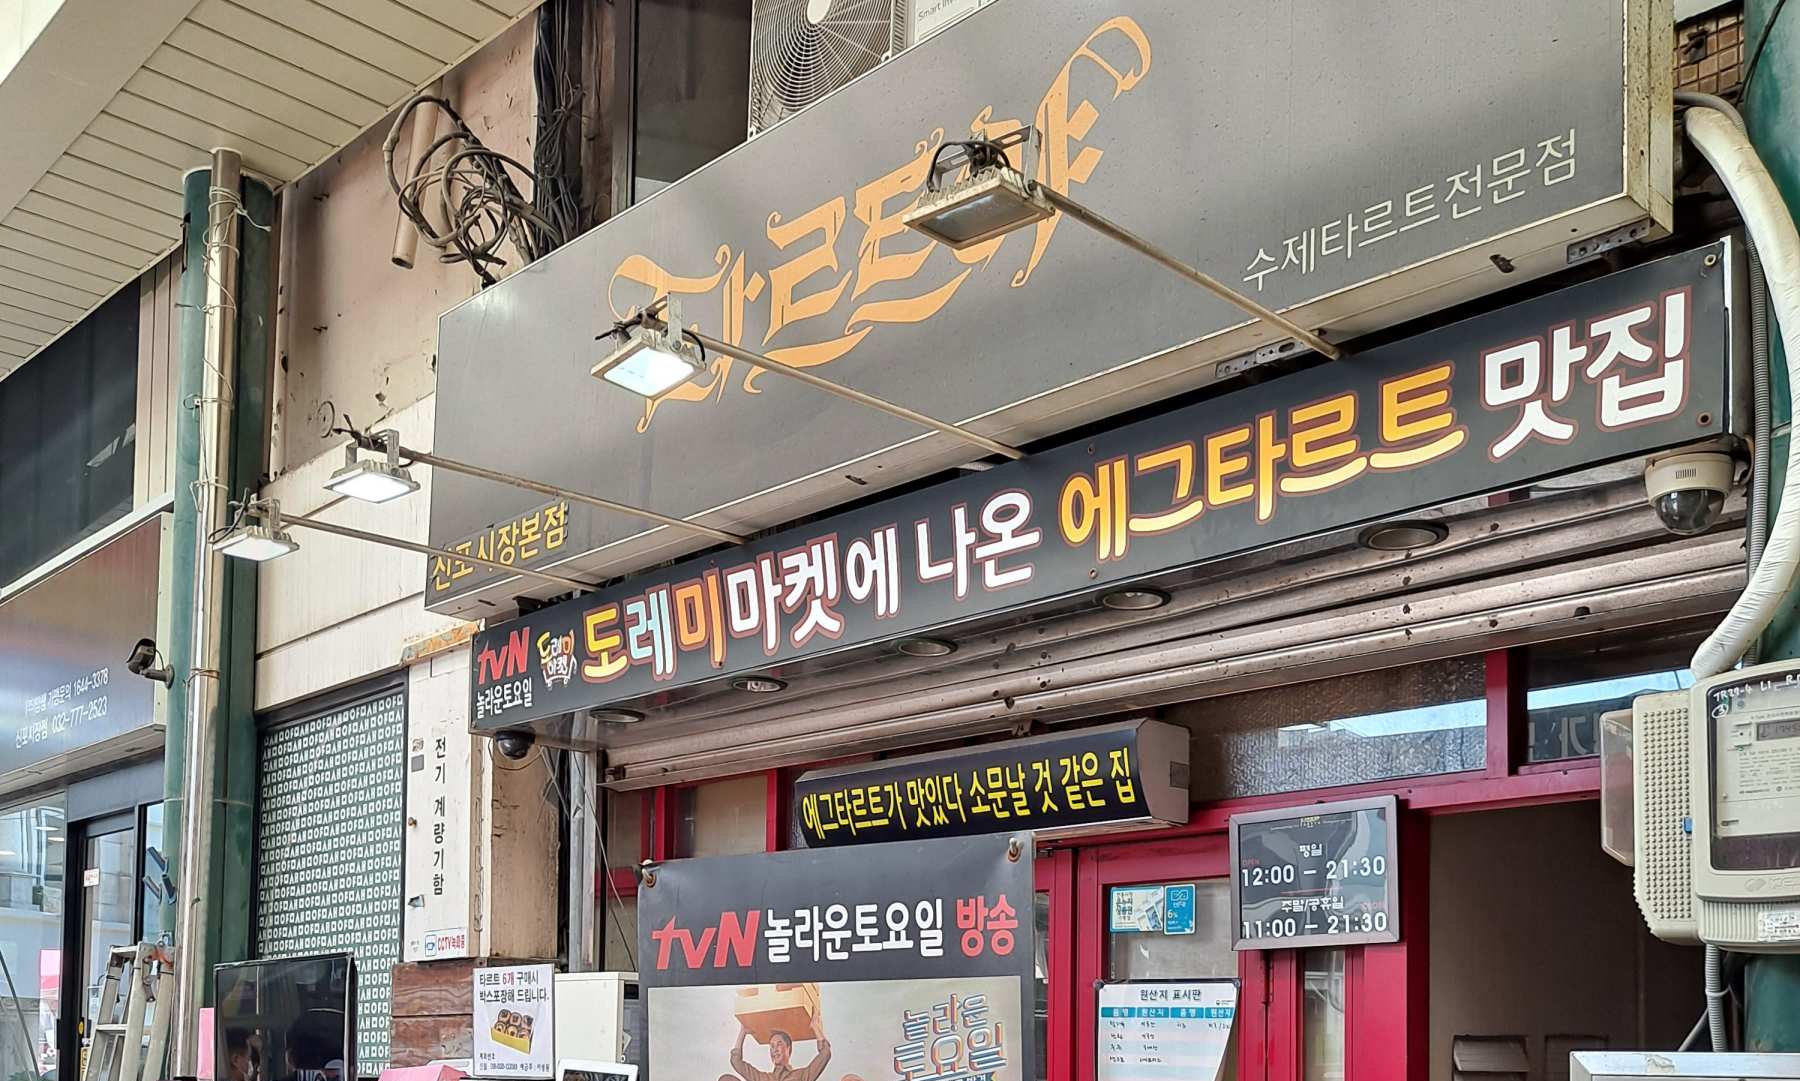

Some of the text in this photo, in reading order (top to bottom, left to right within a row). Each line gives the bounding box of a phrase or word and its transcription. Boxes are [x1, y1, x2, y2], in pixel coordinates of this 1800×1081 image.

[1242, 128, 1578, 292] 수제타르트전문점
[582, 290, 1691, 680] 도레미마켓에 나온 에그타르트 맛집
[431, 501, 569, 591] 신포시장본점
[477, 627, 530, 685] tvN
[476, 677, 533, 719] 놀라운토요일
[433, 736, 447, 895] 전기 계량기함
[802, 747, 1136, 840] 에그타르트가 맛있다 소문날 것 같은 집
[1242, 864, 1294, 887] 12:00
[1326, 855, 1386, 880] 21:30
[1299, 843, 1323, 858] 평일
[1243, 918, 1296, 939] 11:00
[1327, 911, 1387, 934] 21:30
[1281, 896, 1344, 913] 주말/공휴일
[651, 894, 1019, 969] tvN 놀라운토요일 방송
[479, 969, 539, 987] 타르트 6개 구매시
[479, 987, 550, 1004] 박스포장해 드립니다.
[1140, 989, 1169, 1001] 원산지
[902, 993, 990, 1042] 놀라운
